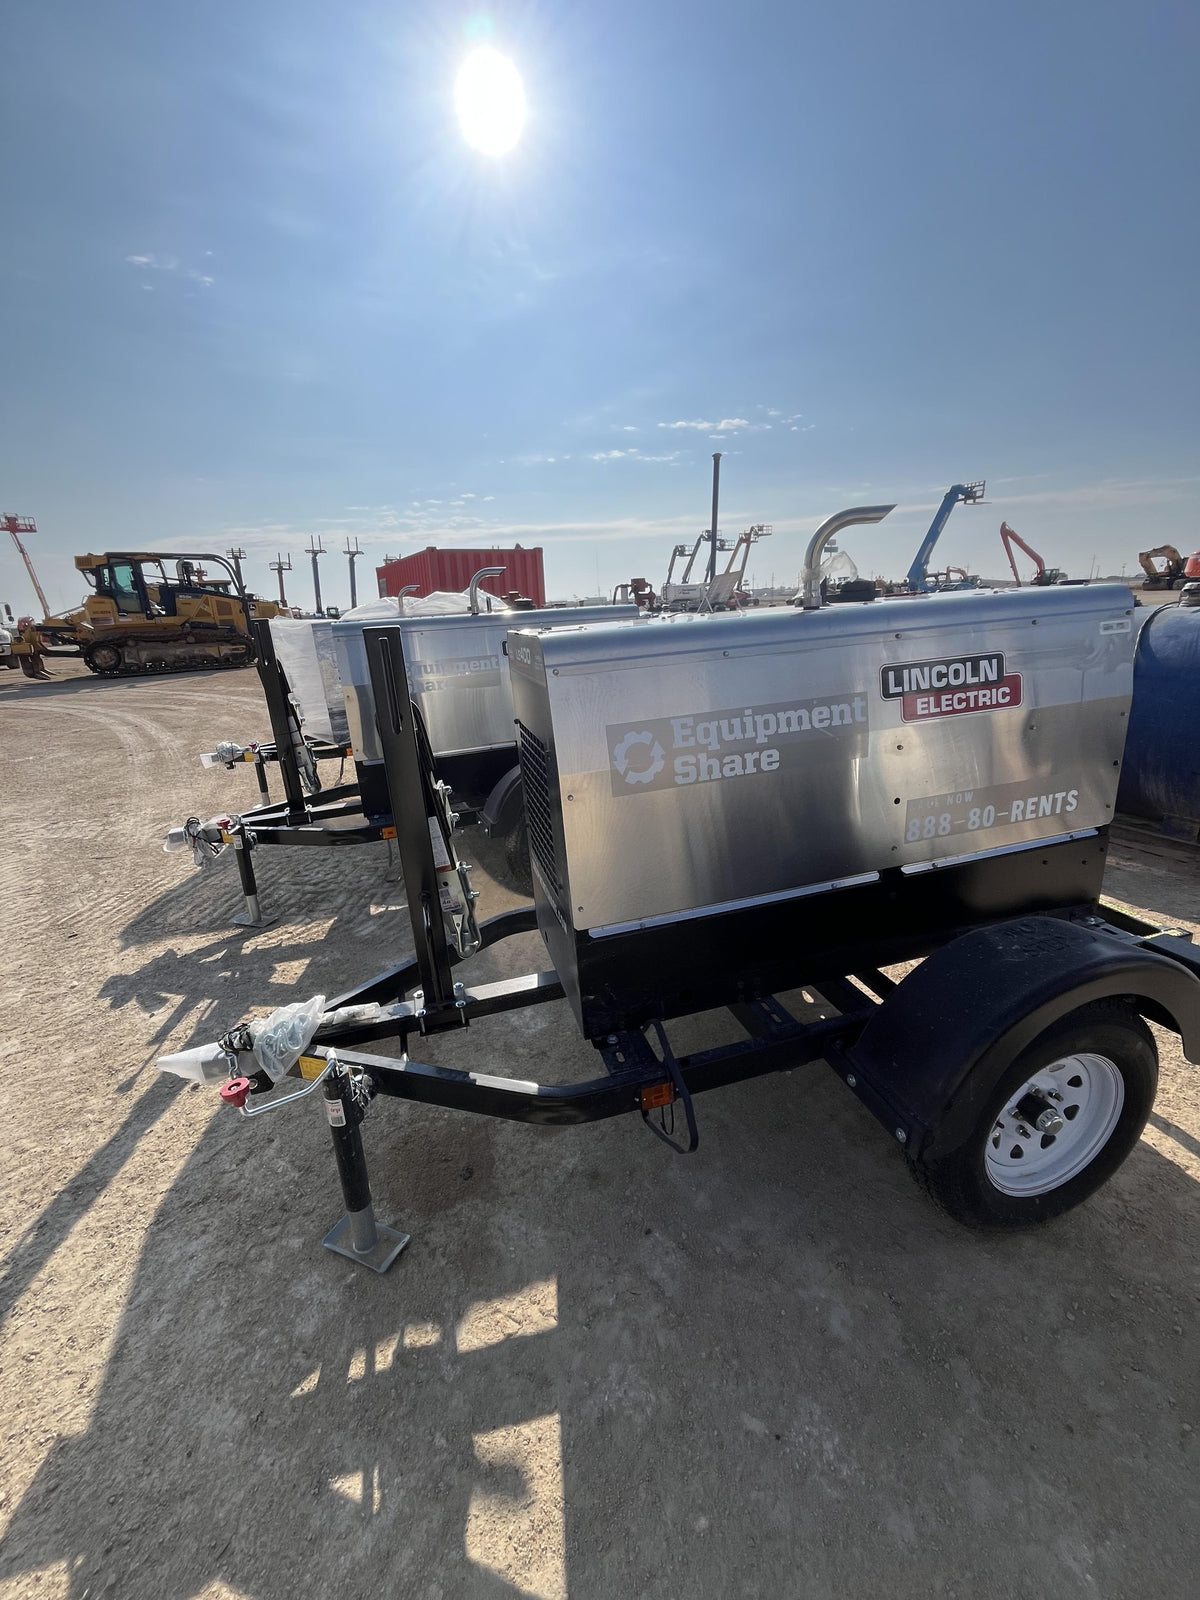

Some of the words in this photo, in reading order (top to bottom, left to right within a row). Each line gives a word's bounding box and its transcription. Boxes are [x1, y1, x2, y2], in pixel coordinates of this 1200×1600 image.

[888, 658, 998, 694] LINCOLN
[916, 686, 1011, 715] ELECTRIC
[670, 697, 867, 750] Equipment
[674, 749, 780, 785] Share
[906, 789, 1079, 841] 888-80-RENTS
[946, 791, 974, 806] NOW
